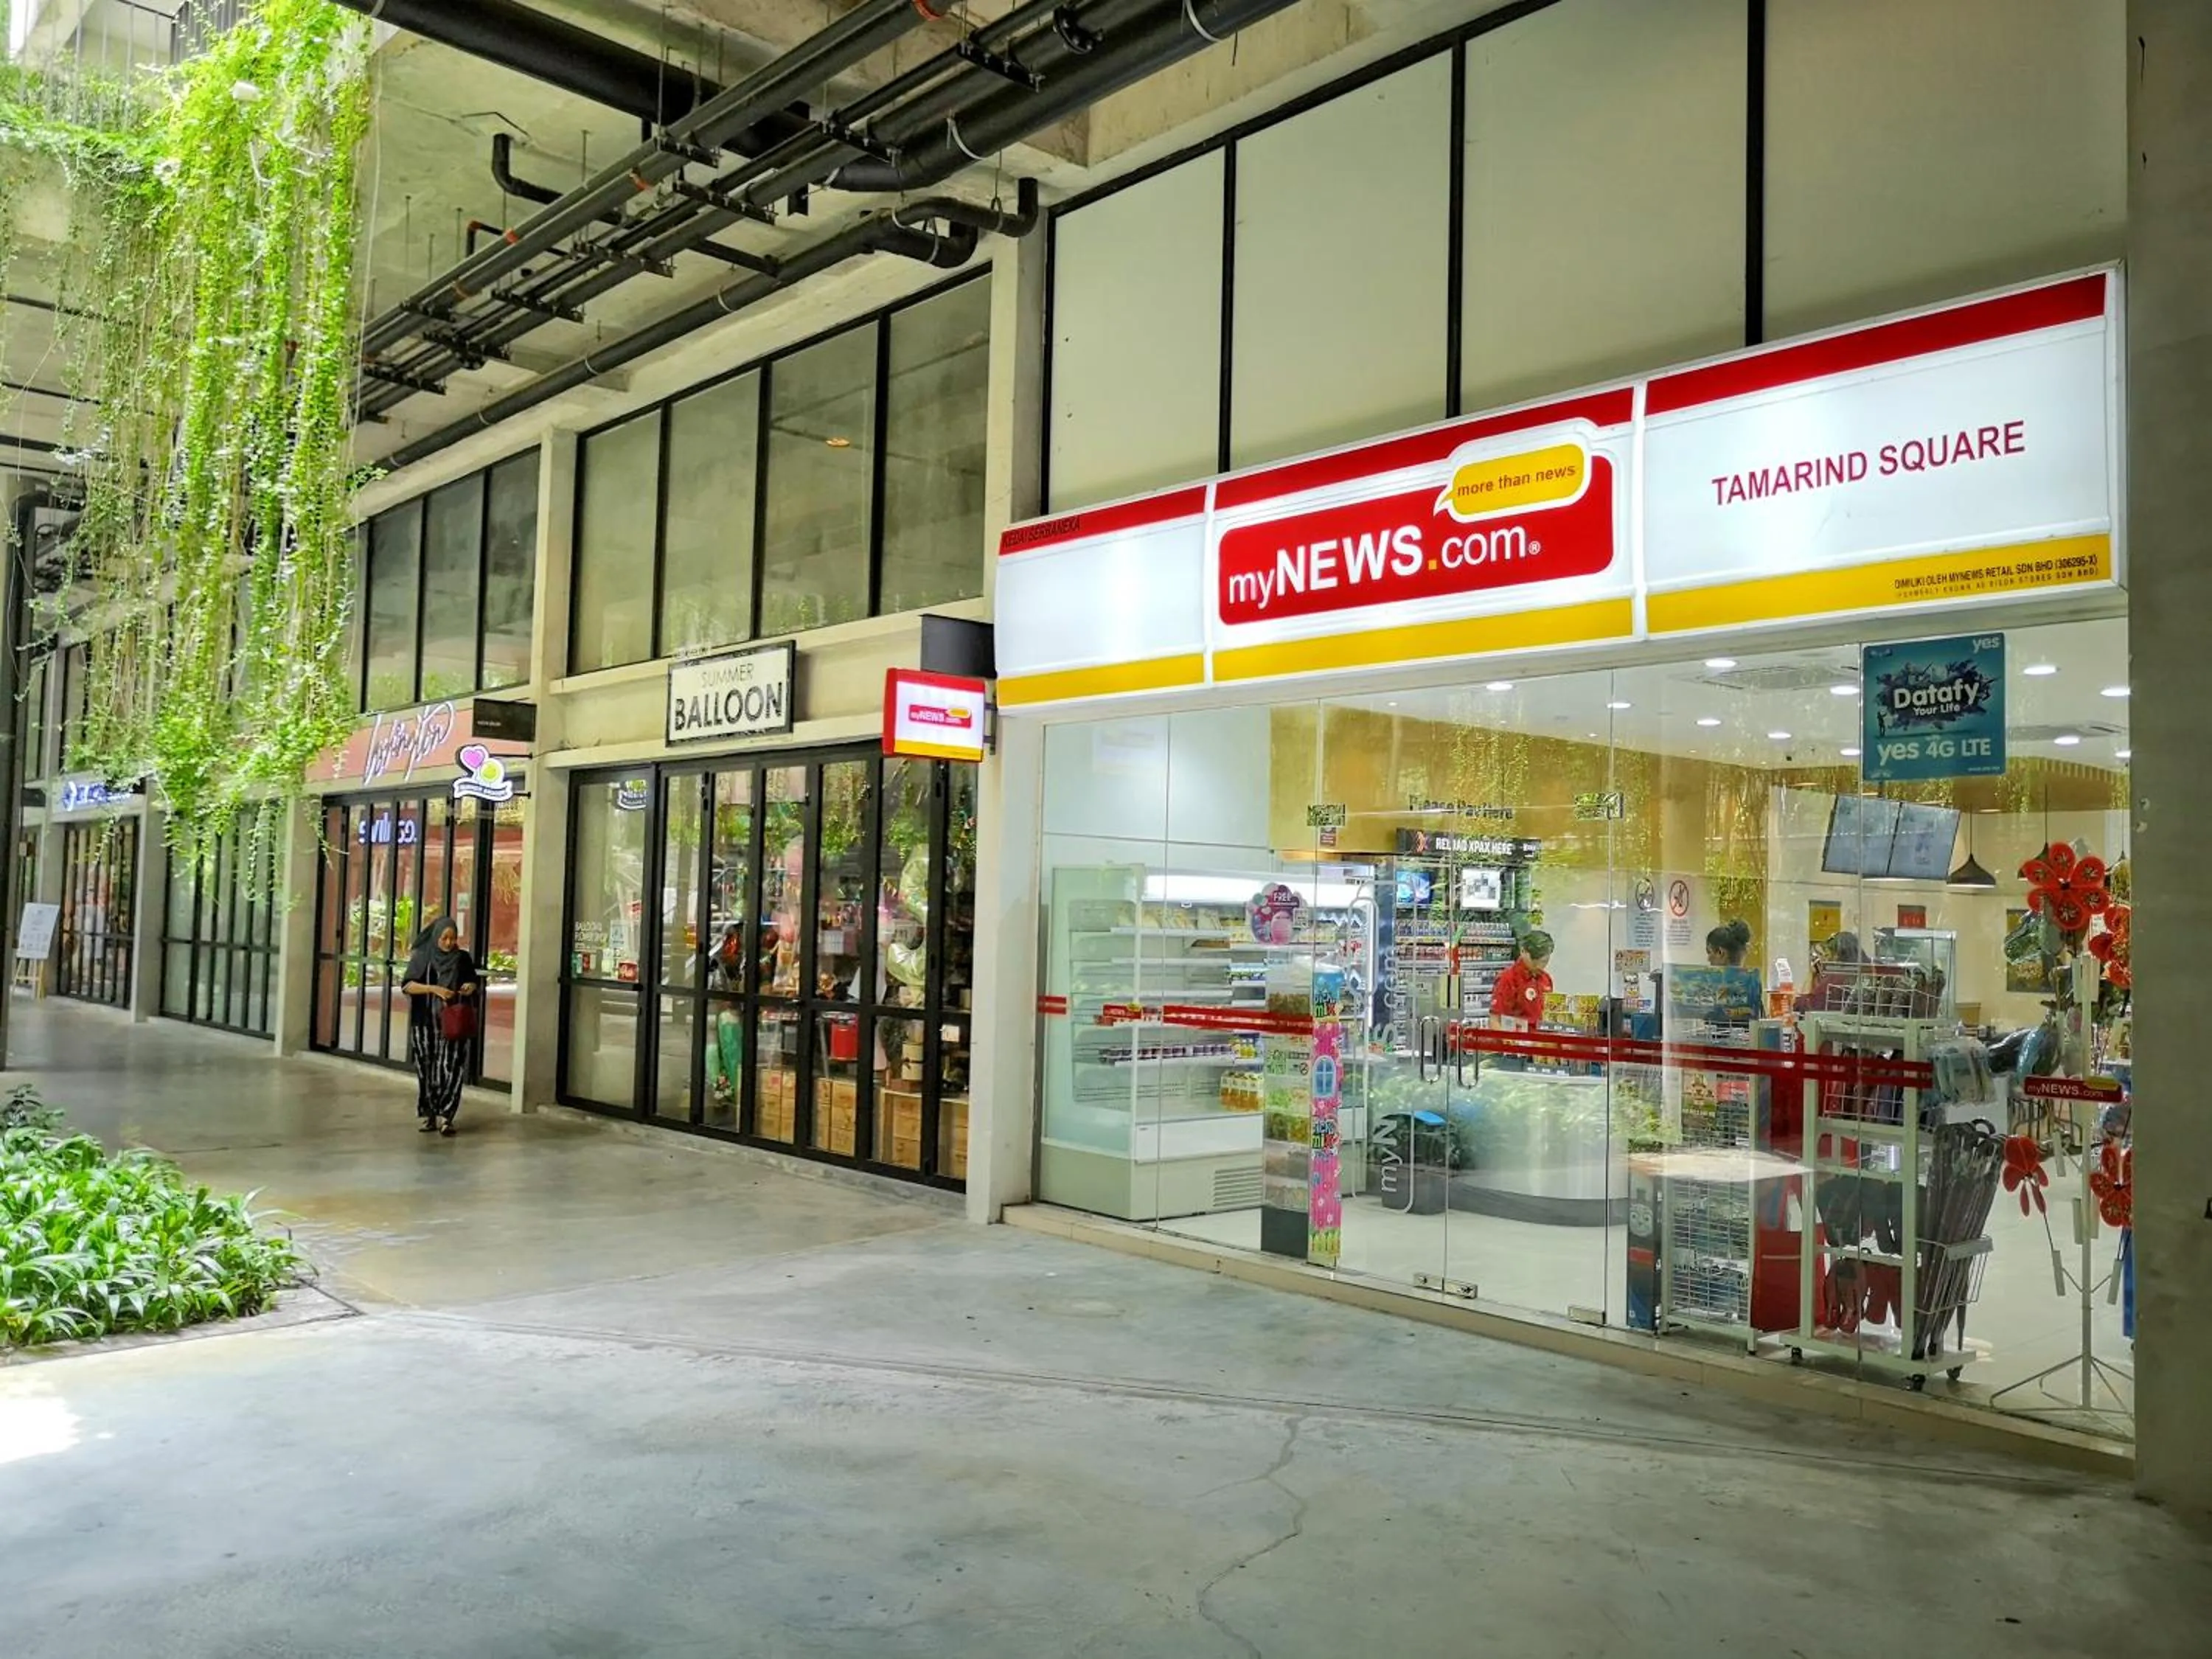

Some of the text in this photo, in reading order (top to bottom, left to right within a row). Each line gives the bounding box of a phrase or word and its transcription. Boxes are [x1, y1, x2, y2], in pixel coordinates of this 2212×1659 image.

[1712, 420, 2025, 506] TAMARIND SQUARE
[1457, 464, 1576, 498] more than news
[1925, 573, 1947, 586] OLEH
[1949, 568, 1984, 582] MYNEWS
[1986, 565, 2014, 577] RETAIL
[2016, 563, 2034, 574] SDN
[2034, 560, 2053, 571] BHD
[1972, 637, 2000, 653] yes
[701, 662, 754, 689] SUMMER
[675, 681, 782, 731] BALLOON
[1893, 678, 1980, 709] Datafy
[1913, 703, 1961, 716] Your Life
[1877, 738, 1992, 767] yes 4G LTE
[1492, 842, 1513, 855] HERE
